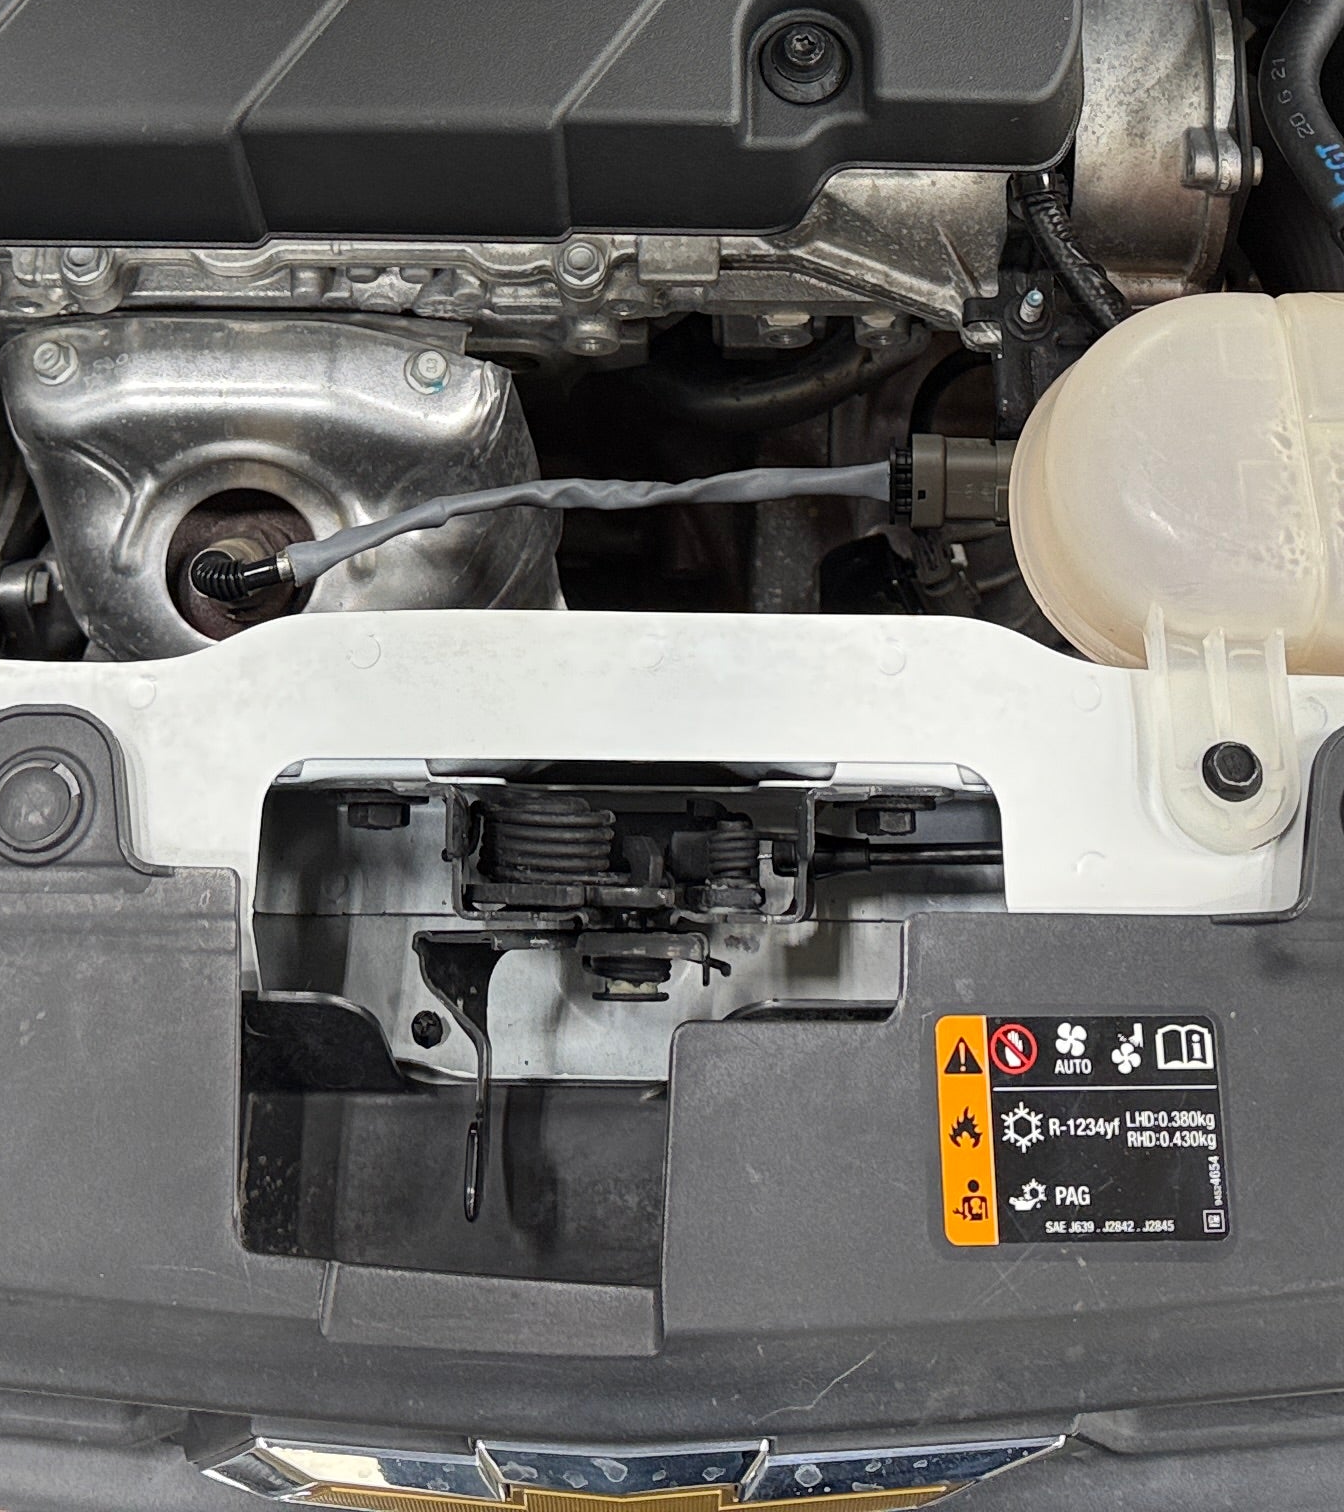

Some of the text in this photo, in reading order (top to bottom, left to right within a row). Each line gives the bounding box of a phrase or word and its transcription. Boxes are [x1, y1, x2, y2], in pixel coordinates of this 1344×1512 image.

[1054, 1058, 1092, 1075] AUTO
[1048, 1117, 1121, 1139] R-1234yf
[1125, 1110, 1216, 1131] LHD:0.380kg
[1127, 1131, 1217, 1150] RHD:0.430kg
[1055, 1186, 1091, 1205] PAG
[1045, 1220, 1067, 1233] SAE
[1068, 1220, 1095, 1233] J639
[1142, 1220, 1174, 1232] J2845
